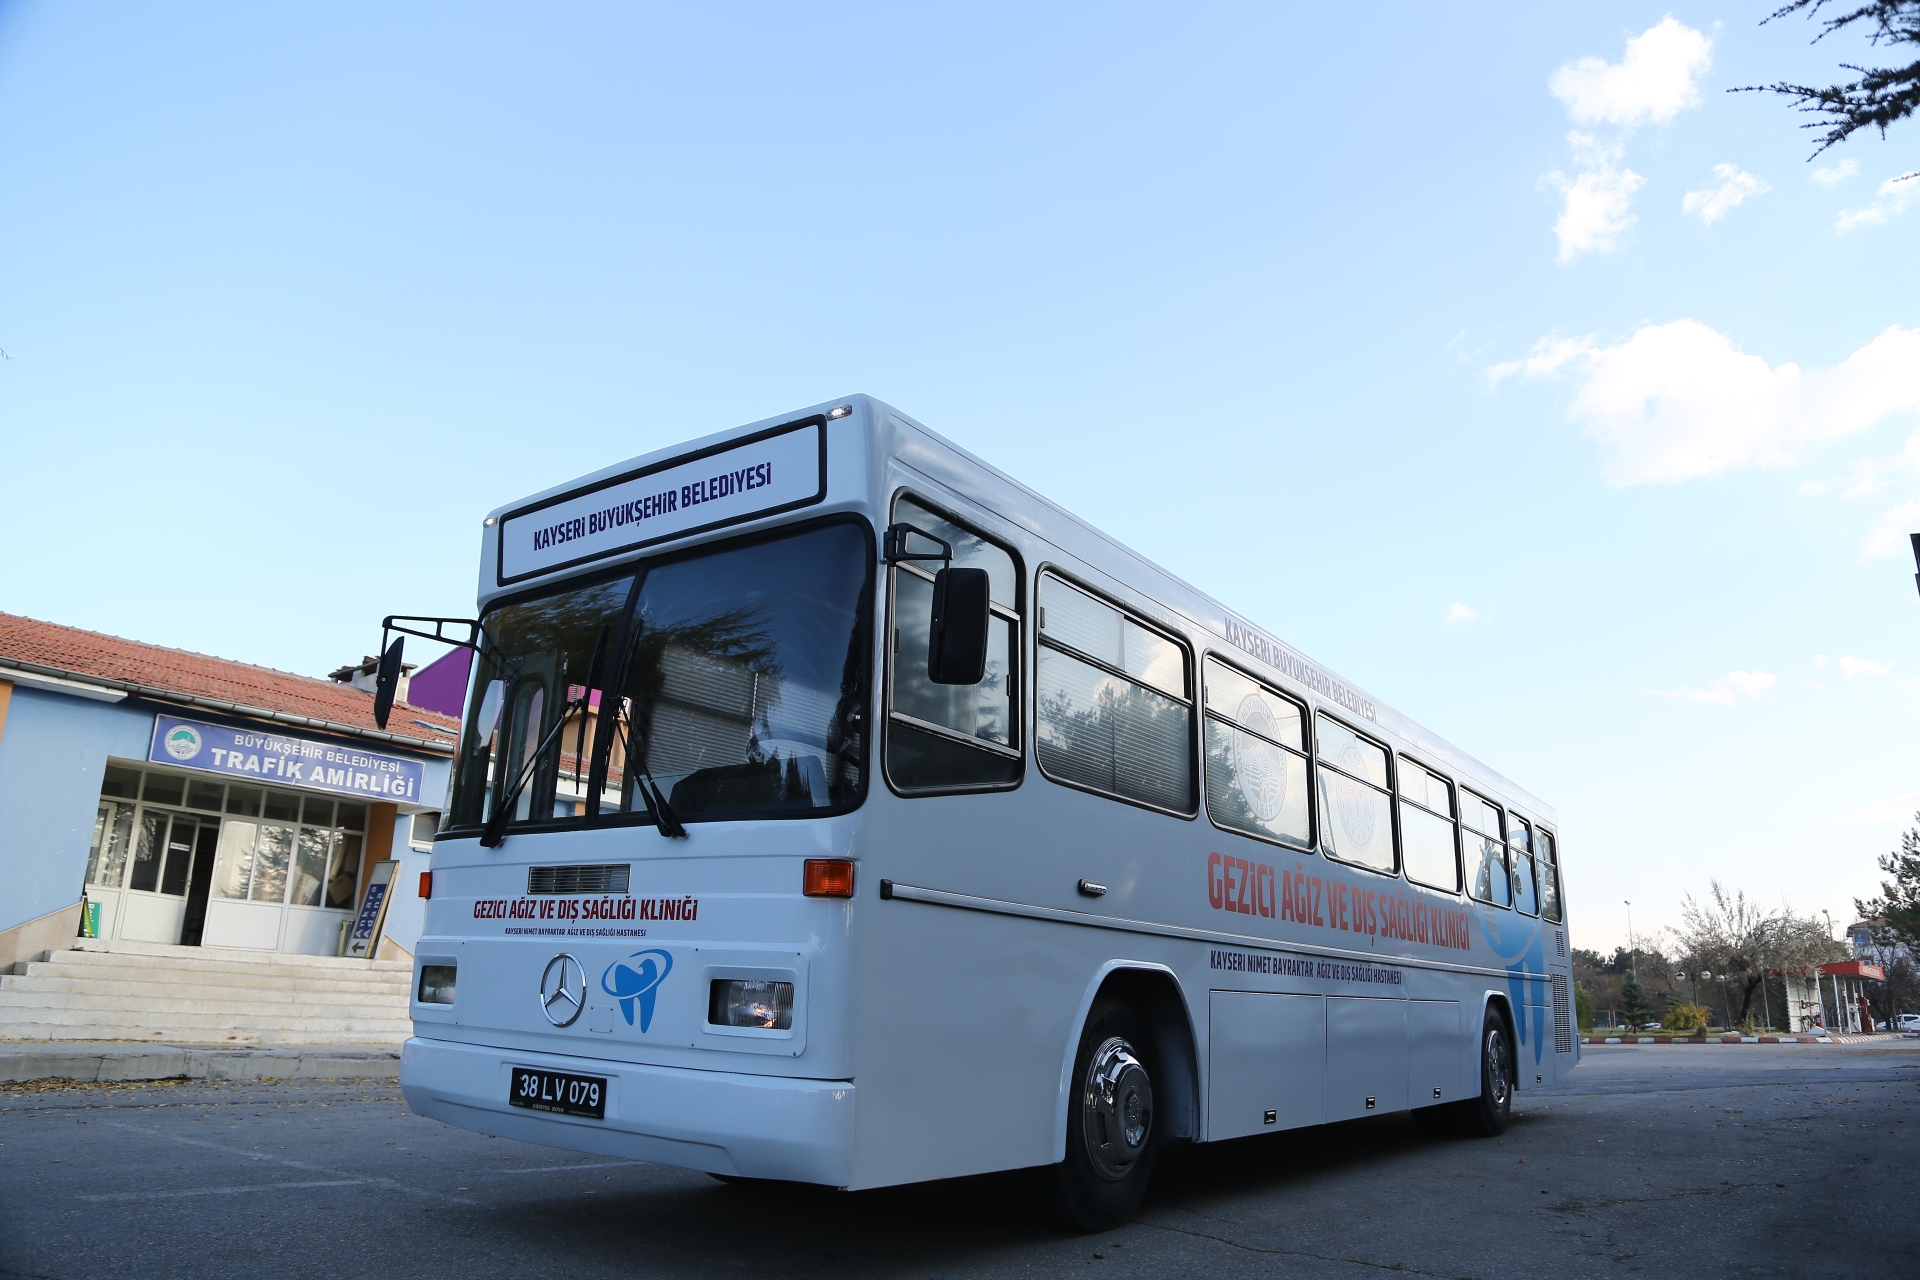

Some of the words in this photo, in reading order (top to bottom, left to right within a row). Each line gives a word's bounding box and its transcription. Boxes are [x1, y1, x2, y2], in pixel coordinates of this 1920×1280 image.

[534, 516, 586, 551] KAYSERİ
[589, 489, 678, 535] BÜYÜKŞEHİR
[681, 461, 772, 508] BELEDİYESİ
[1224, 617, 1272, 664] KAYSERİ
[1273, 645, 1331, 697] BÜYÜKŞEHİR
[1331, 680, 1377, 723] BELEDİYESİ
[211, 747, 304, 780] TRAFİK
[309, 766, 414, 797] AMİRLİĞİ
[234, 734, 323, 760] BÜYÜKŞEHİR
[326, 751, 400, 773] BELEDİYESİ
[1255, 801, 1273, 818] 1869
[356, 886, 377, 937] Ankara
[363, 892, 383, 938] Adana
[473, 900, 507, 918] GEZİCİ
[508, 896, 537, 919] AĞIZ
[539, 899, 556, 919] VE
[557, 899, 579, 924] DİŞ
[581, 895, 637, 920] SAĞLIĞI
[639, 895, 698, 920] KLİNİĞİ
[1208, 852, 1276, 919] GEZİCİ
[1281, 862, 1324, 927] AĞIZ
[1326, 879, 1349, 931] VE
[1351, 886, 1377, 946] DİŞ
[1379, 889, 1429, 944] SAĞLIĞI
[1431, 904, 1470, 951] KLİNİĞİ
[538, 928, 566, 936] BAYRAKTAR
[579, 928, 586, 937] VE
[596, 927, 616, 937] SAĞLIĞI
[1210, 950, 1246, 972] KAYSERİ
[1247, 954, 1272, 974] NİMET
[1273, 957, 1314, 978] BAYRAKTAR
[1316, 960, 1331, 979] AĞIZ
[1332, 963, 1340, 980] VE
[1341, 964, 1351, 985] DİŞ
[1351, 964, 1373, 983] SAĞLIĞI
[520, 1074, 539, 1098] 38
[542, 1076, 566, 1101] LV
[569, 1081, 600, 1107] 079
